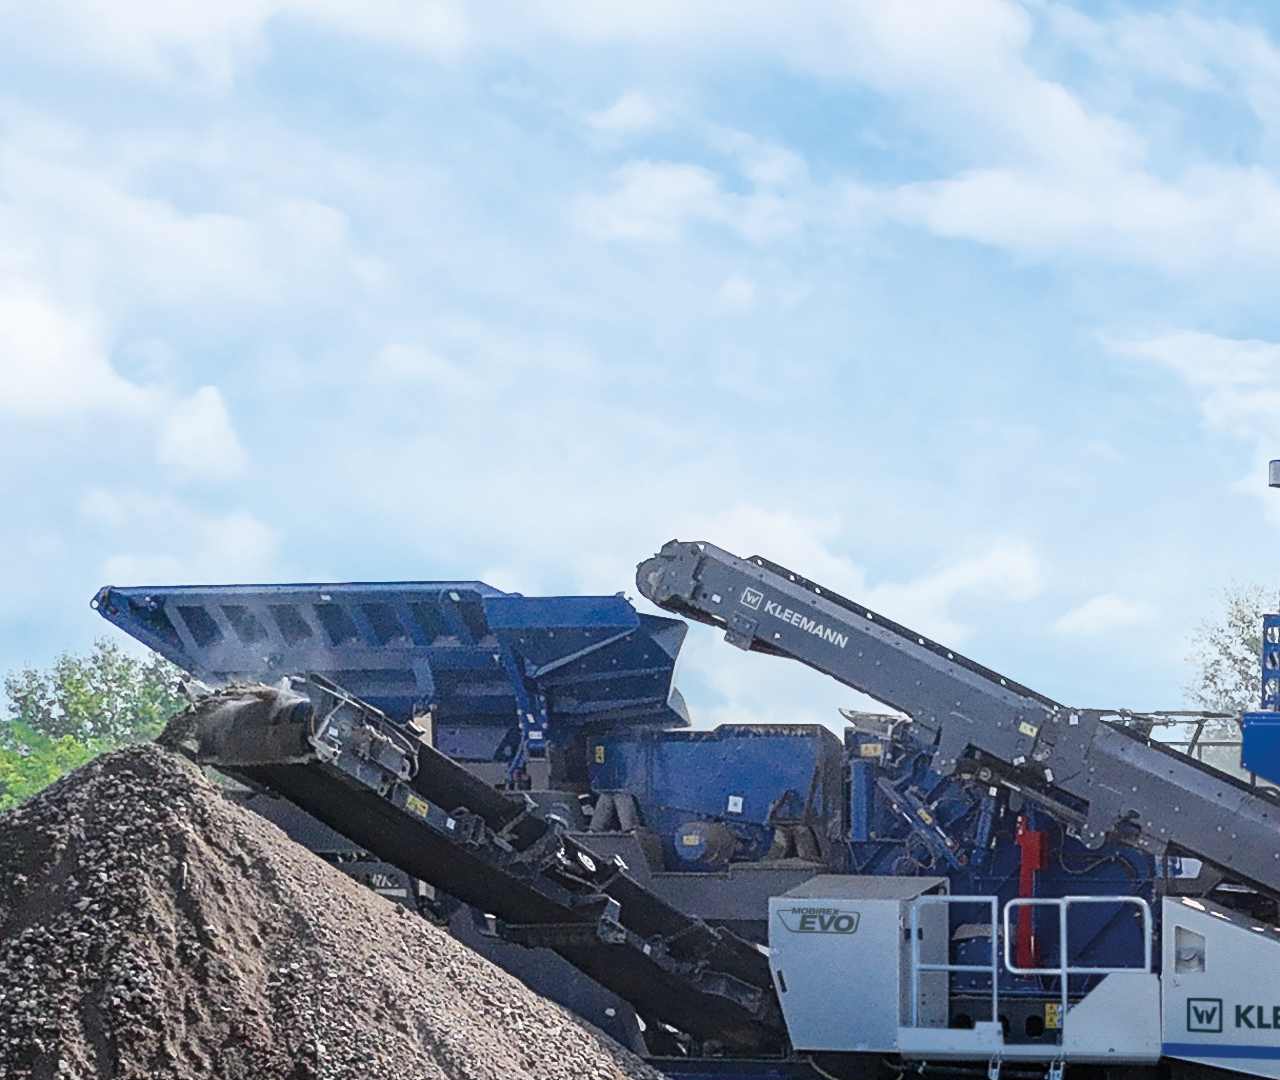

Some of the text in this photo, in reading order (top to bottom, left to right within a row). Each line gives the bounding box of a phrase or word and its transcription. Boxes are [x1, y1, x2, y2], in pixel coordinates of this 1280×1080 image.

[763, 600, 849, 649] KLEEMANN
[791, 907, 840, 916] MOBIREX
[798, 914, 855, 932] EVO
